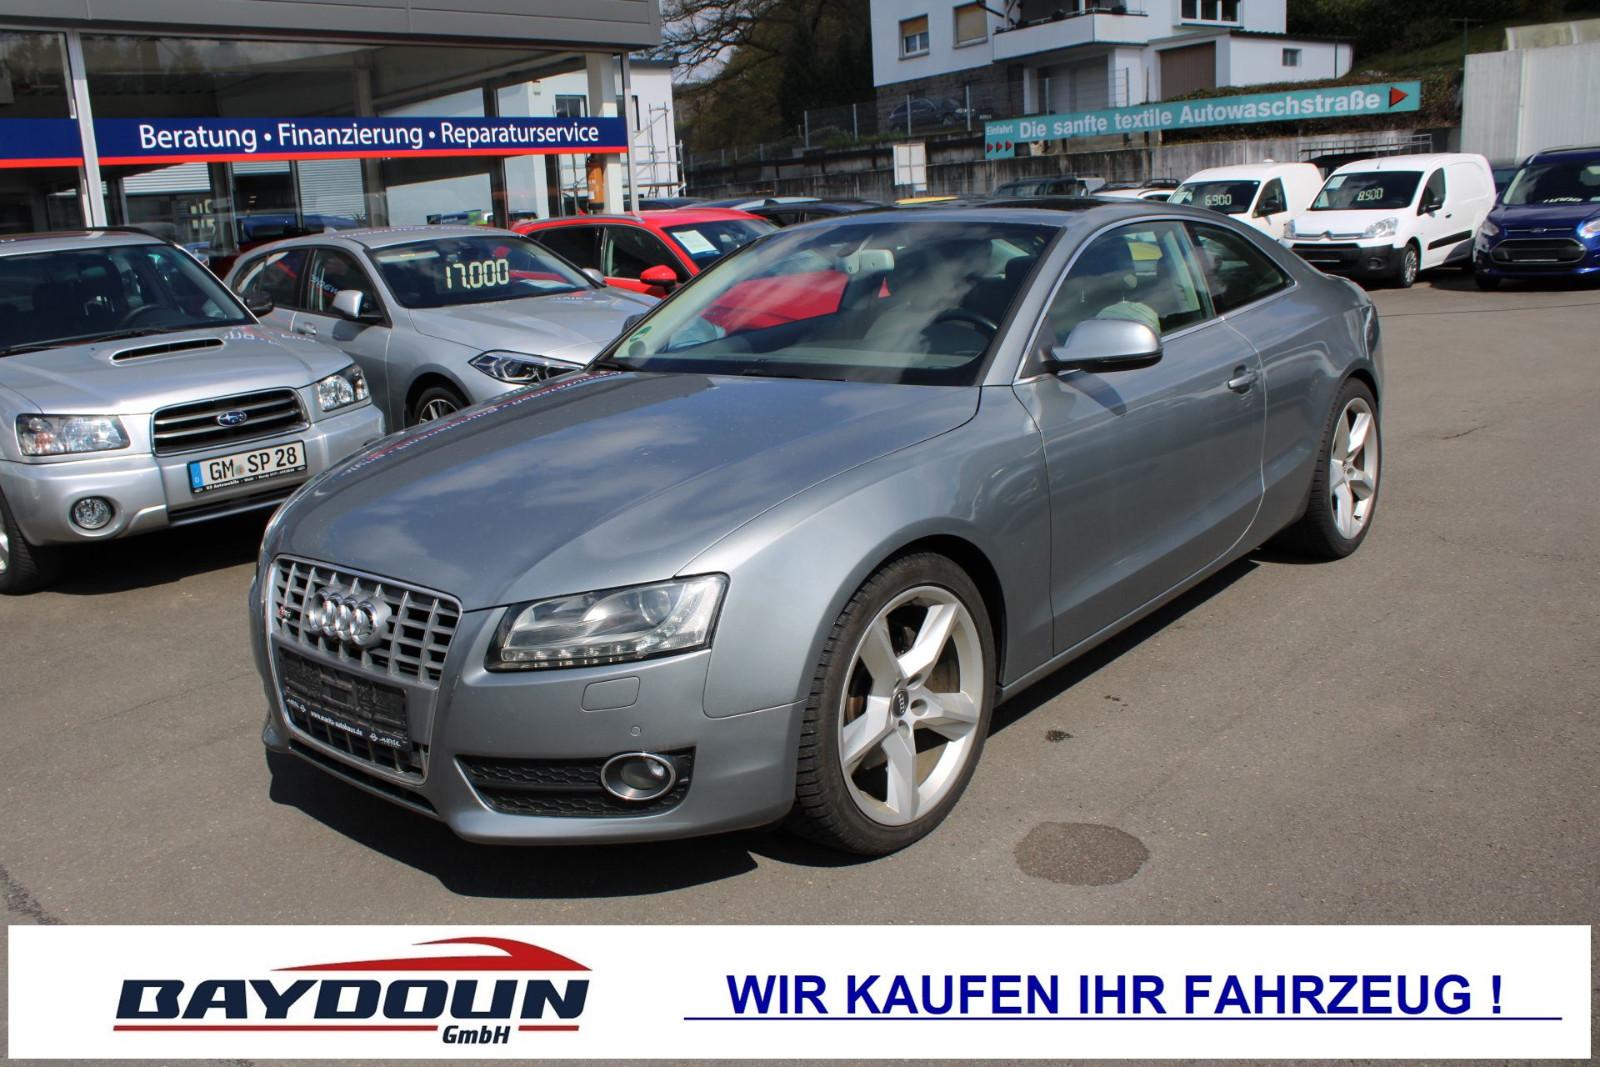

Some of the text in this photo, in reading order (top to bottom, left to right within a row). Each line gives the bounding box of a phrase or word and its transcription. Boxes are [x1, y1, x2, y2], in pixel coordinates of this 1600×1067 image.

[1020, 90, 1381, 138] Die sanfte textile Autowaschstraße
[139, 121, 599, 153] Beratung Finanzierung Reparaturservice
[445, 258, 510, 289] 17.000
[209, 447, 297, 480] GM SP 28
